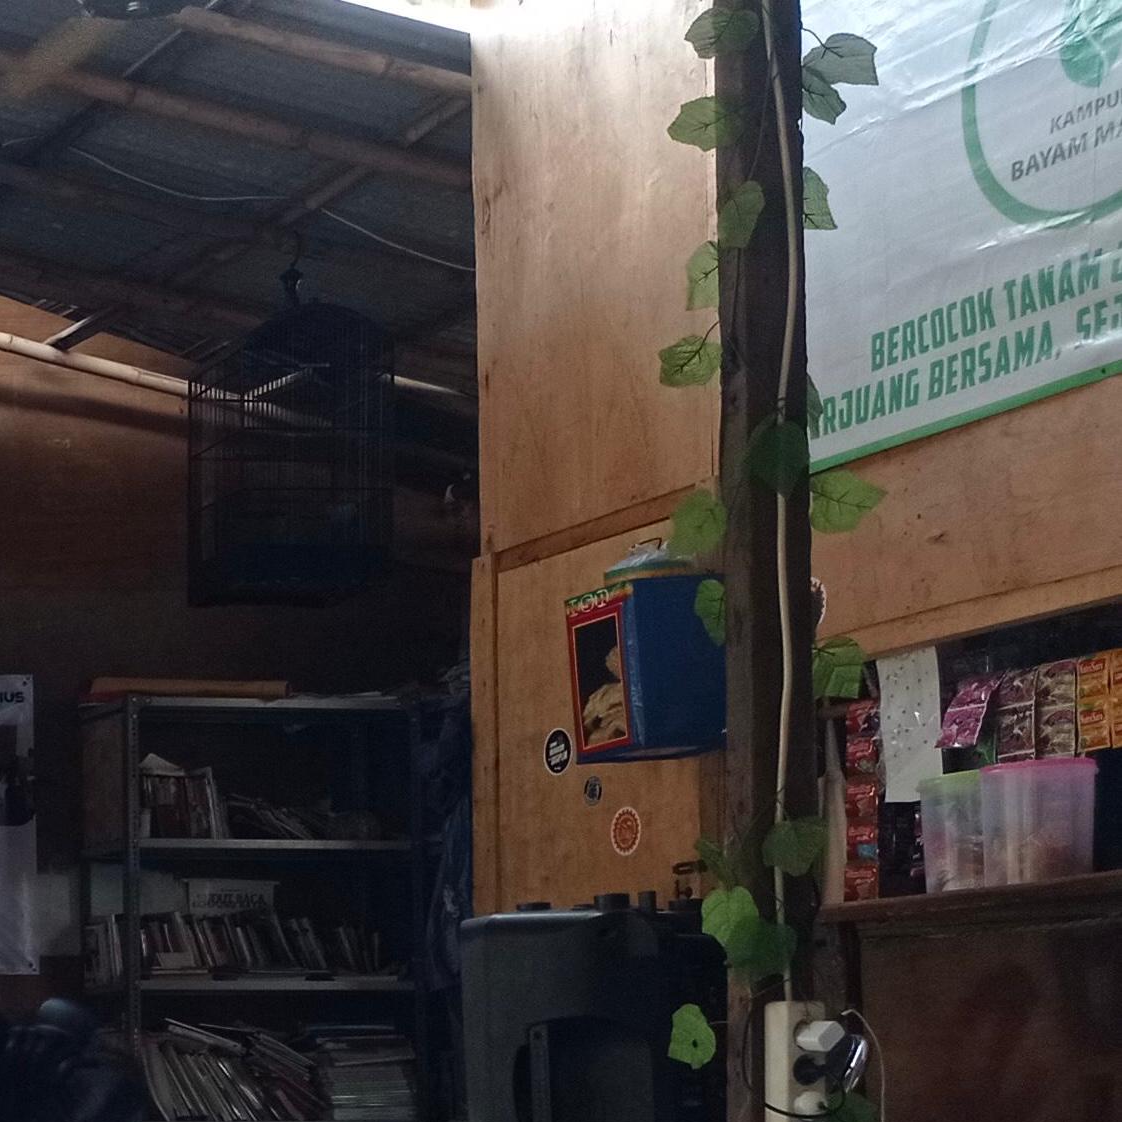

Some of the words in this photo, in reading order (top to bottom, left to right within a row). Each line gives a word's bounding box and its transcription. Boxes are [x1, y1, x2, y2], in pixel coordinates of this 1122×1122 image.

[1050, 87, 1122, 134] KAMPU
[1011, 132, 1088, 182] BAYAM
[870, 286, 996, 372] BERCOCOK
[1003, 245, 1104, 322] TANAM
[822, 368, 920, 436] RJUANG
[928, 320, 1063, 401] BERSAMA,
